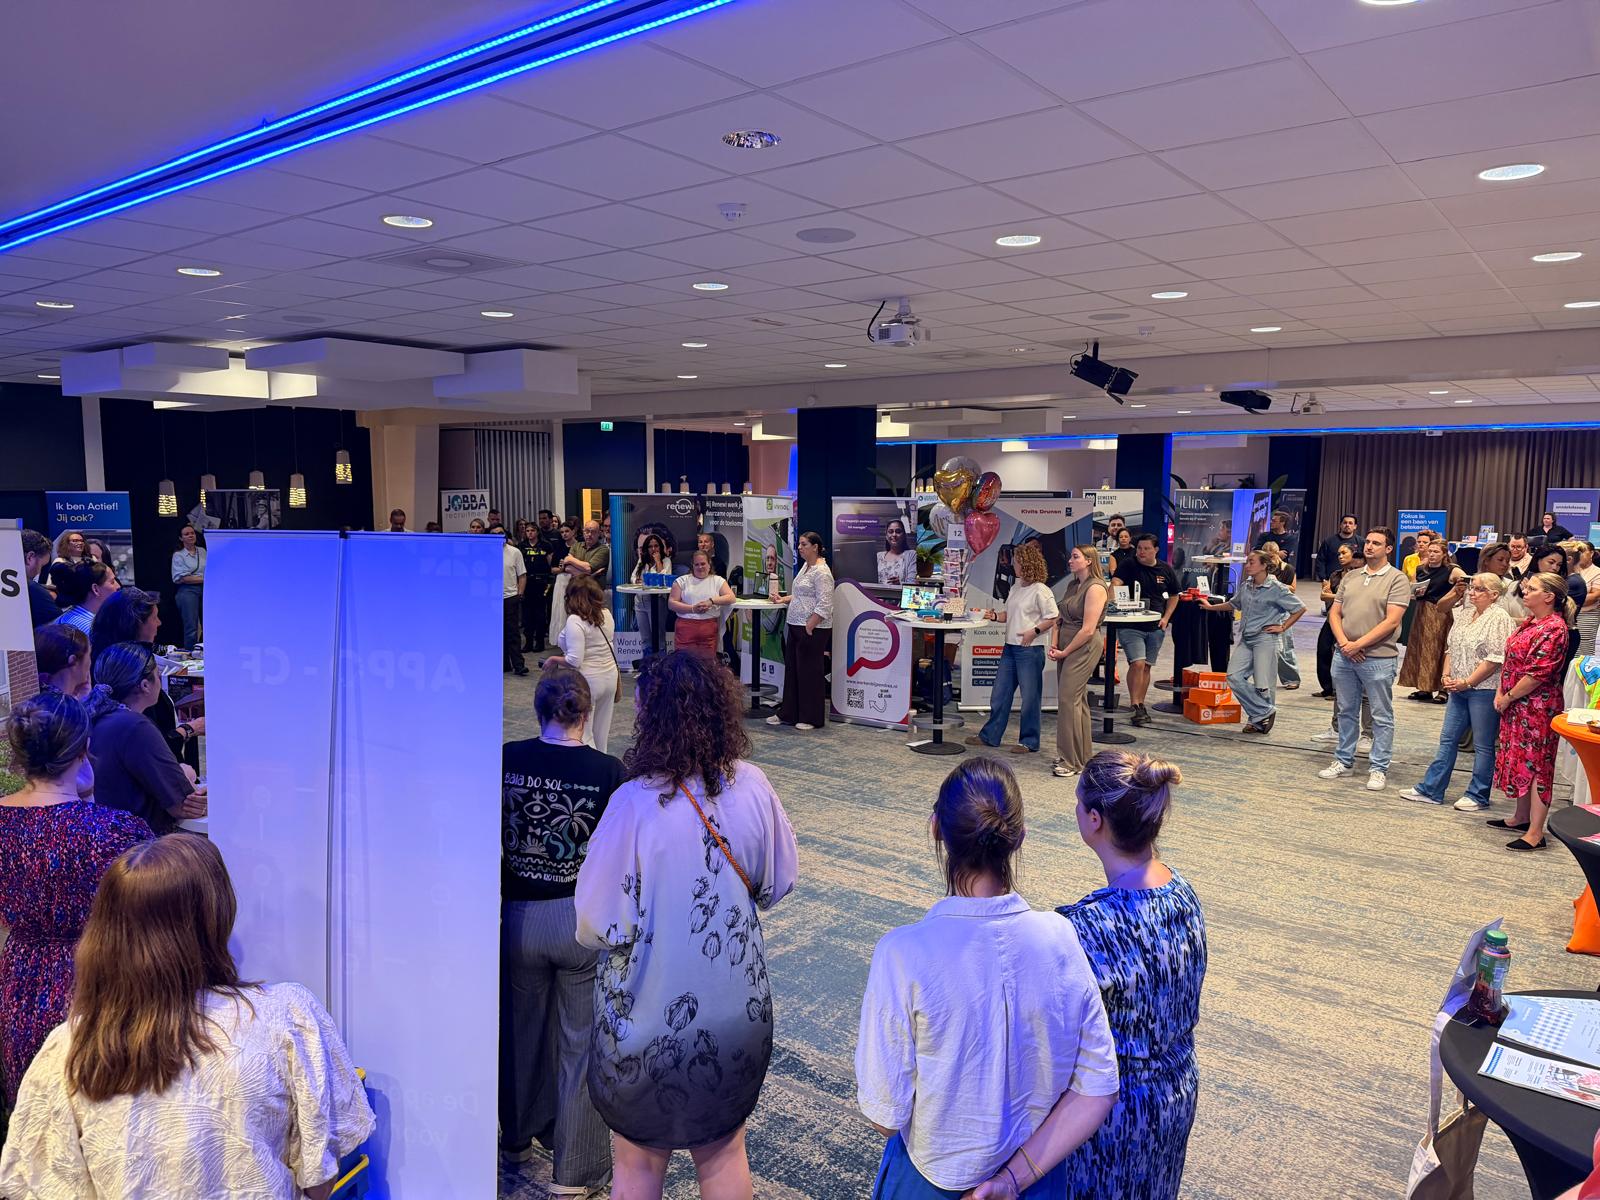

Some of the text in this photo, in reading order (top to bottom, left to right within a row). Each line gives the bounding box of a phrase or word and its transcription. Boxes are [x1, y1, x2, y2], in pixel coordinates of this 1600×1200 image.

[55, 502, 118, 512] Ik ben Actief!
[445, 493, 488, 512] JOBBA
[56, 513, 94, 524] Jij ook?
[1, 569, 21, 598] S
[617, 637, 637, 646] Word
[617, 647, 642, 655] Renew
[526, 775, 542, 788] DO
[543, 778, 563, 791] SOL
